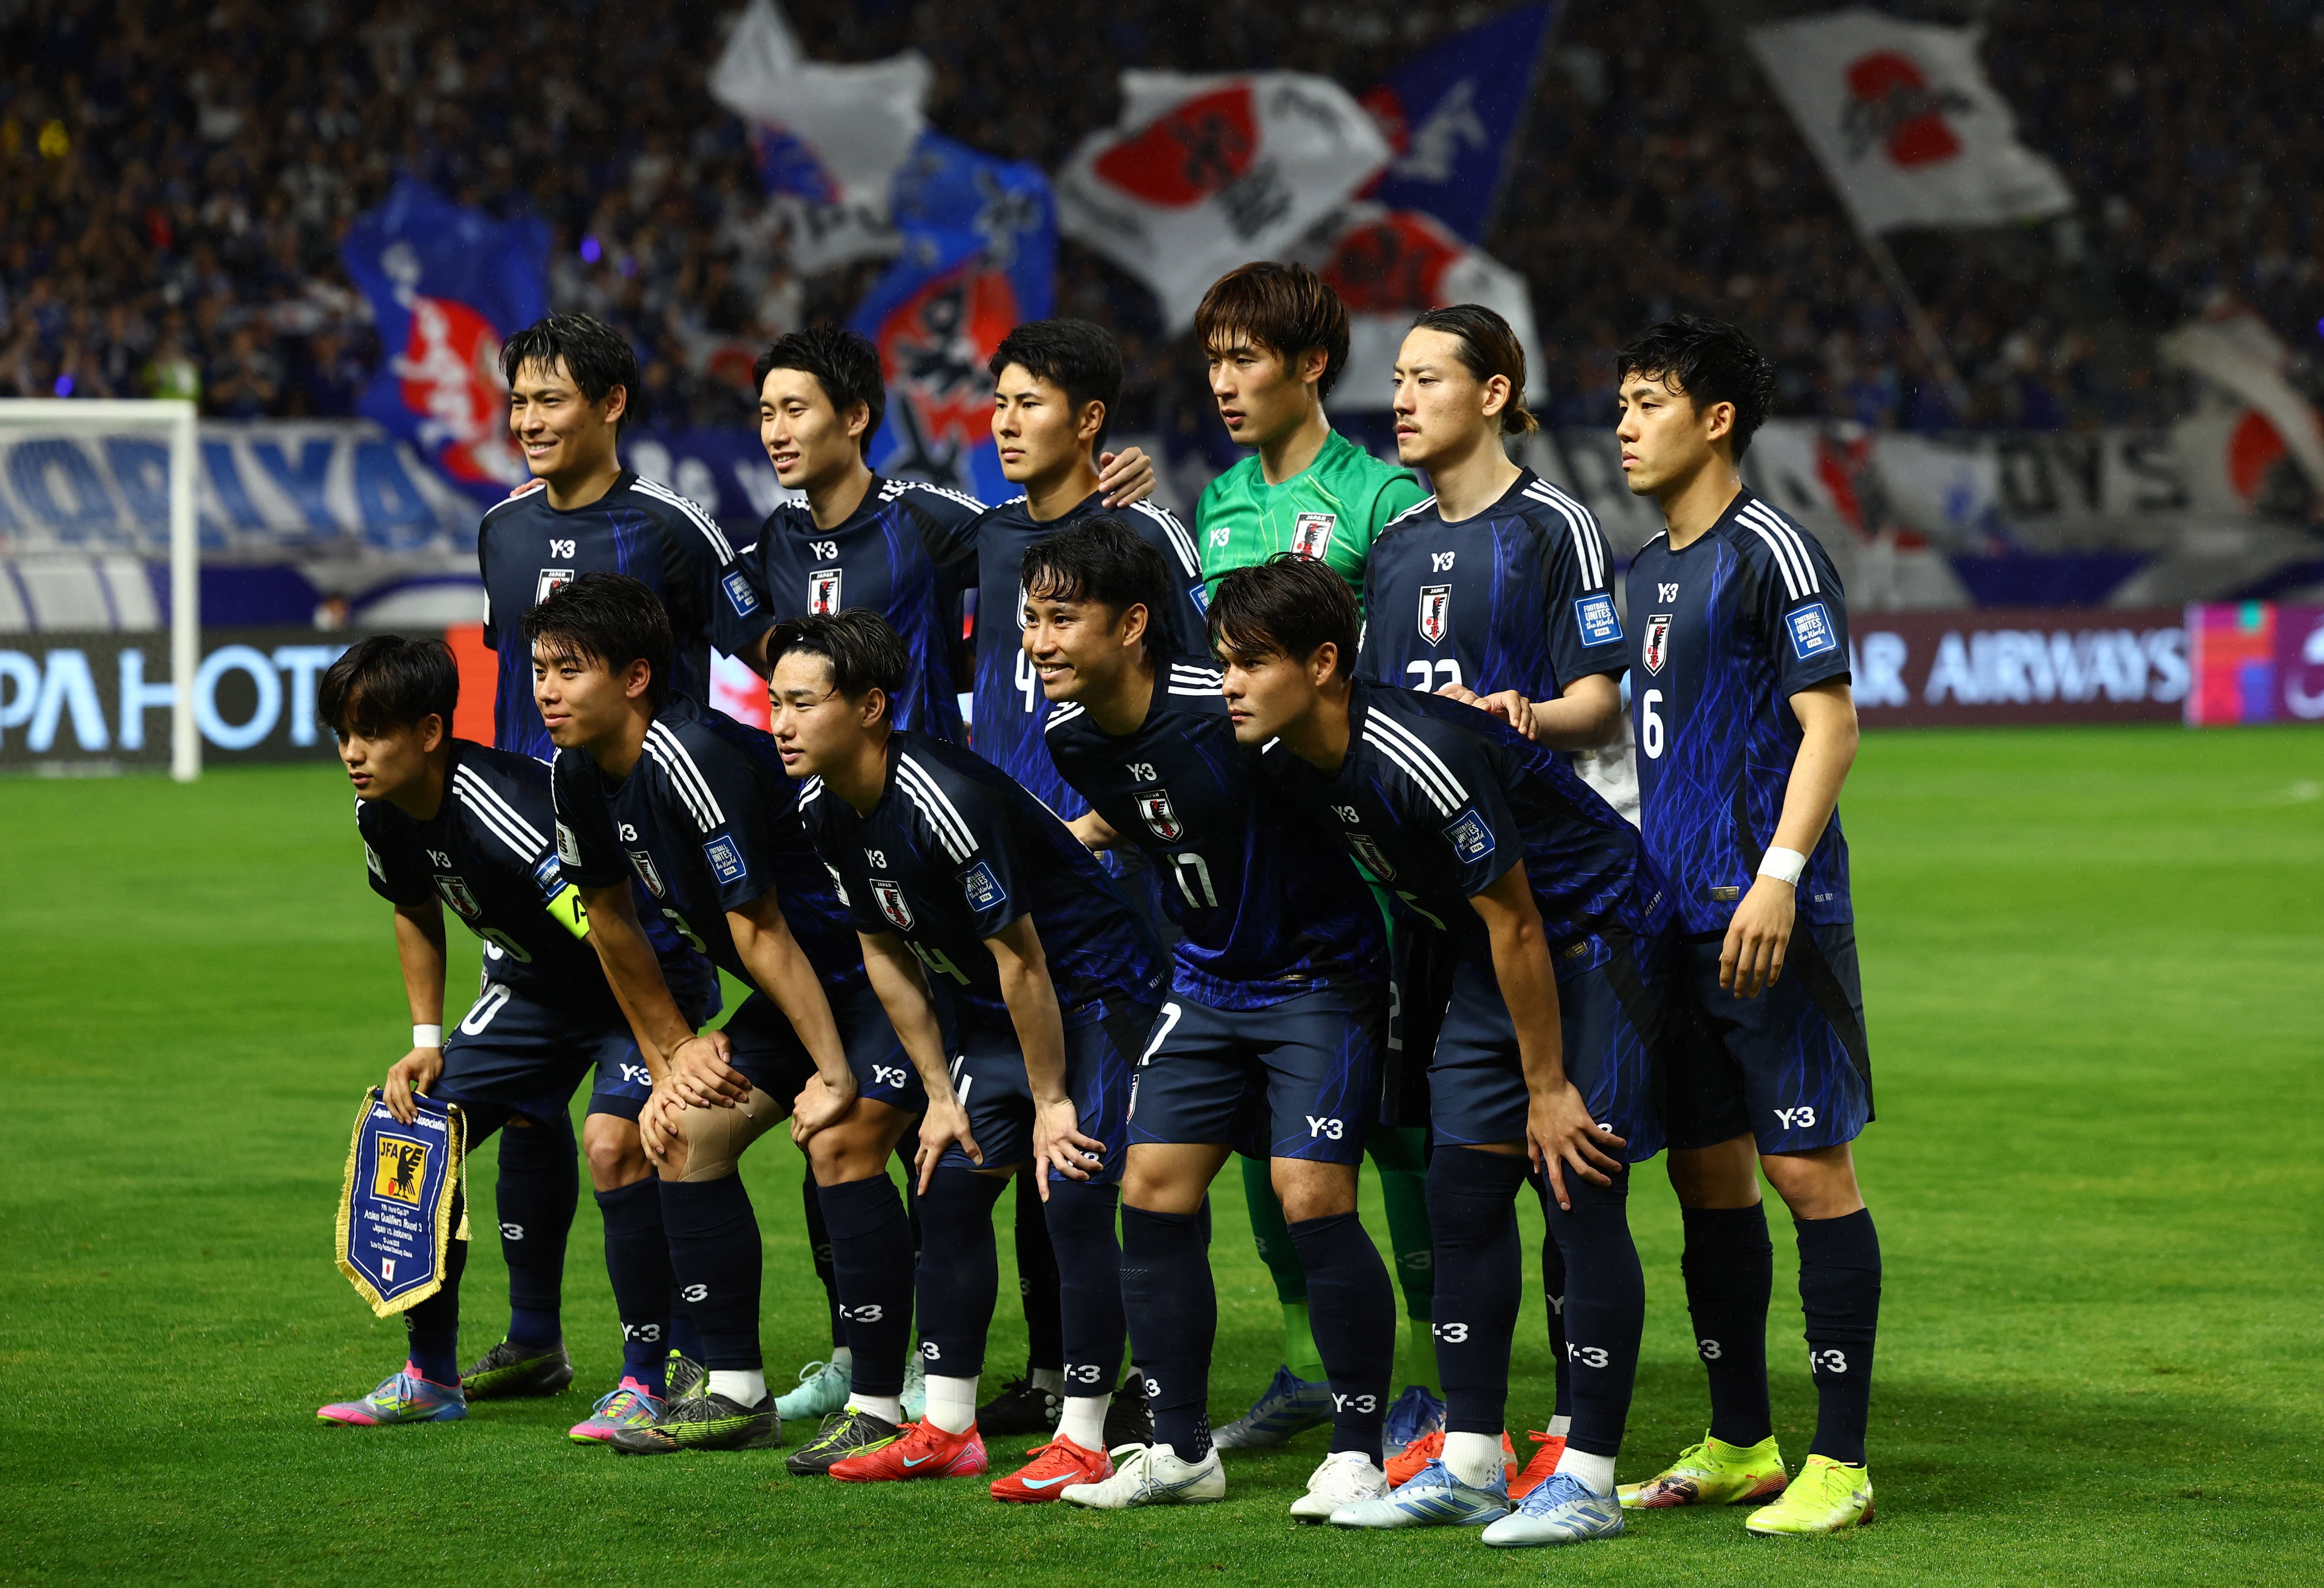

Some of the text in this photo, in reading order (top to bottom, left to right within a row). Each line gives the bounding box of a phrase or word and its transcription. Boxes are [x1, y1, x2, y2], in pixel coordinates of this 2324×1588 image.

[1209, 527, 1230, 548] Y-3
[549, 540, 576, 559] Y-3
[809, 541, 838, 560] Y-3
[1431, 551, 1455, 573] Y-3
[1657, 583, 1679, 603] Y-3
[1583, 601, 1610, 613] FOOTBALL
[1585, 608, 1611, 621] UNITES
[1585, 616, 1614, 630] the World
[1794, 611, 1820, 626] FOOTBALL
[1796, 618, 1822, 634] UNITES
[1798, 626, 1826, 643] the World
[1922, 628, 2191, 706] AIRWAYS
[1015, 647, 1036, 712] 4
[1643, 689, 1664, 759] 6
[1125, 763, 1157, 782] Y-3
[1330, 805, 1360, 823] Y-3
[1451, 819, 1474, 837] FOOTBALL
[1456, 824, 1479, 843] UNITES
[709, 843, 728, 855] FOOTBALL
[1459, 830, 1485, 851] the World
[426, 849, 451, 868] Y-3
[712, 849, 732, 863] UNITES
[721, 855, 737, 868] World
[864, 848, 887, 868] Y-3
[977, 882, 994, 894] World
[1167, 853, 1218, 908] 17
[1644, 890, 1663, 917] HEAT.RDY
[1814, 893, 1834, 903] HEAT.RDY
[872, 1065, 907, 1088] Y-3
[416, 1114, 446, 1133] Association
[1305, 1115, 1343, 1140] Y-3
[1774, 1107, 1815, 1130] Y-3
[380, 1142, 398, 1159] JFA
[364, 1209, 423, 1233] Asian Qualifiers Round 3
[372, 1223, 386, 1235] Japan
[393, 1227, 413, 1242] Indonesia
[1332, 1393, 1376, 1413] Y-3
